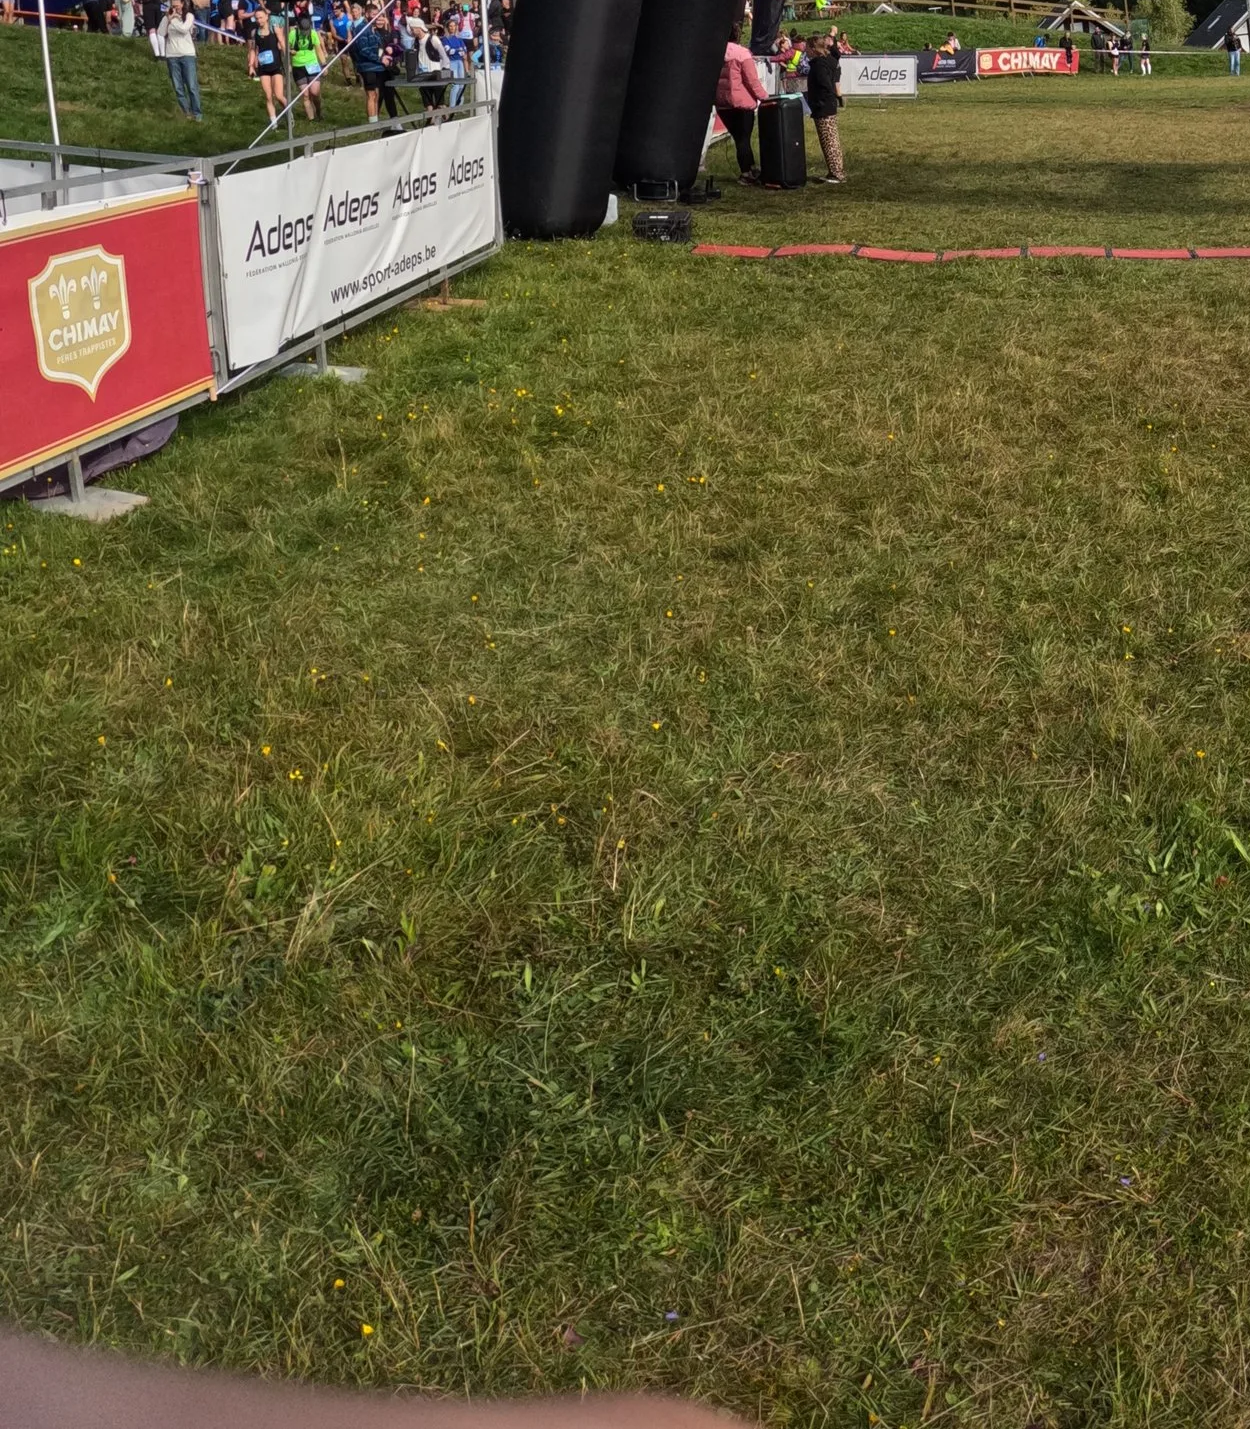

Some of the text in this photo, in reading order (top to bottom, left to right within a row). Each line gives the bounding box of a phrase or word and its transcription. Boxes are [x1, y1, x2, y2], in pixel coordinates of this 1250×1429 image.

[858, 65, 907, 83] Adeps
[997, 52, 1061, 71] CHIMAY
[392, 172, 437, 209] Adeps
[447, 155, 484, 188] Adeps
[323, 190, 380, 232] Adeps
[245, 214, 314, 262] Adeps
[330, 244, 437, 304] www.sport-adeps.be
[48, 309, 120, 351] CHIMAY
